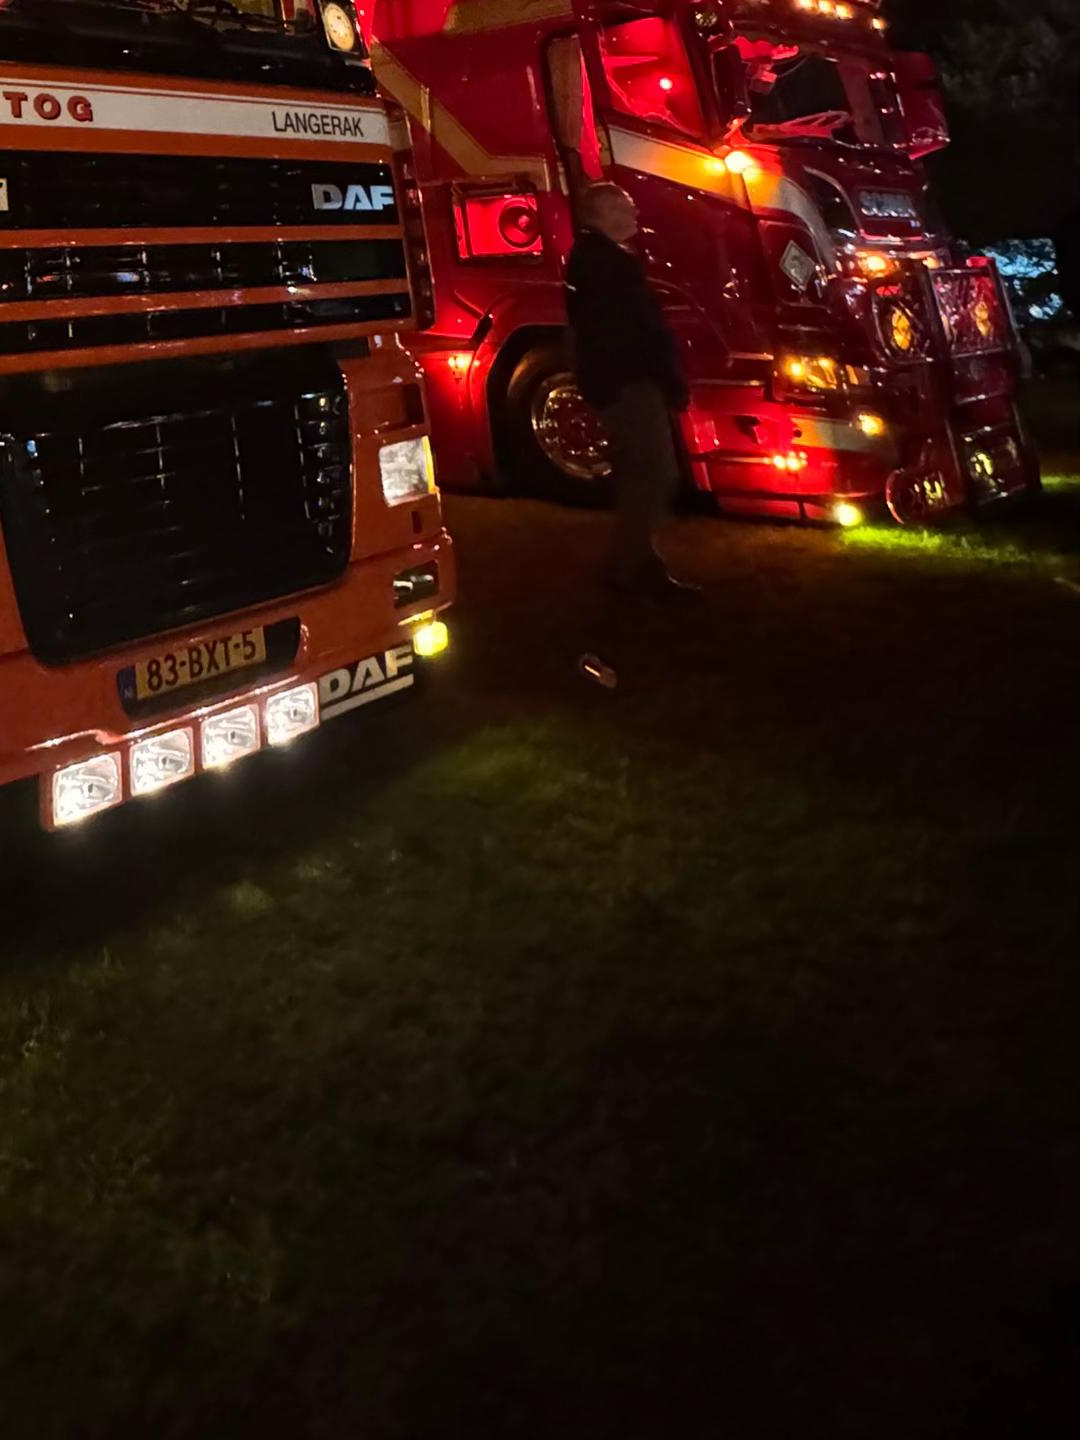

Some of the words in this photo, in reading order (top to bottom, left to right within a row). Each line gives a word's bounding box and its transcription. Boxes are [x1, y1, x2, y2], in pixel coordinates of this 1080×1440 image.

[272, 111, 364, 138] LANGERAK
[311, 183, 395, 210] DAF
[146, 630, 257, 692] 83-BXT-5
[319, 644, 413, 703] DAF
